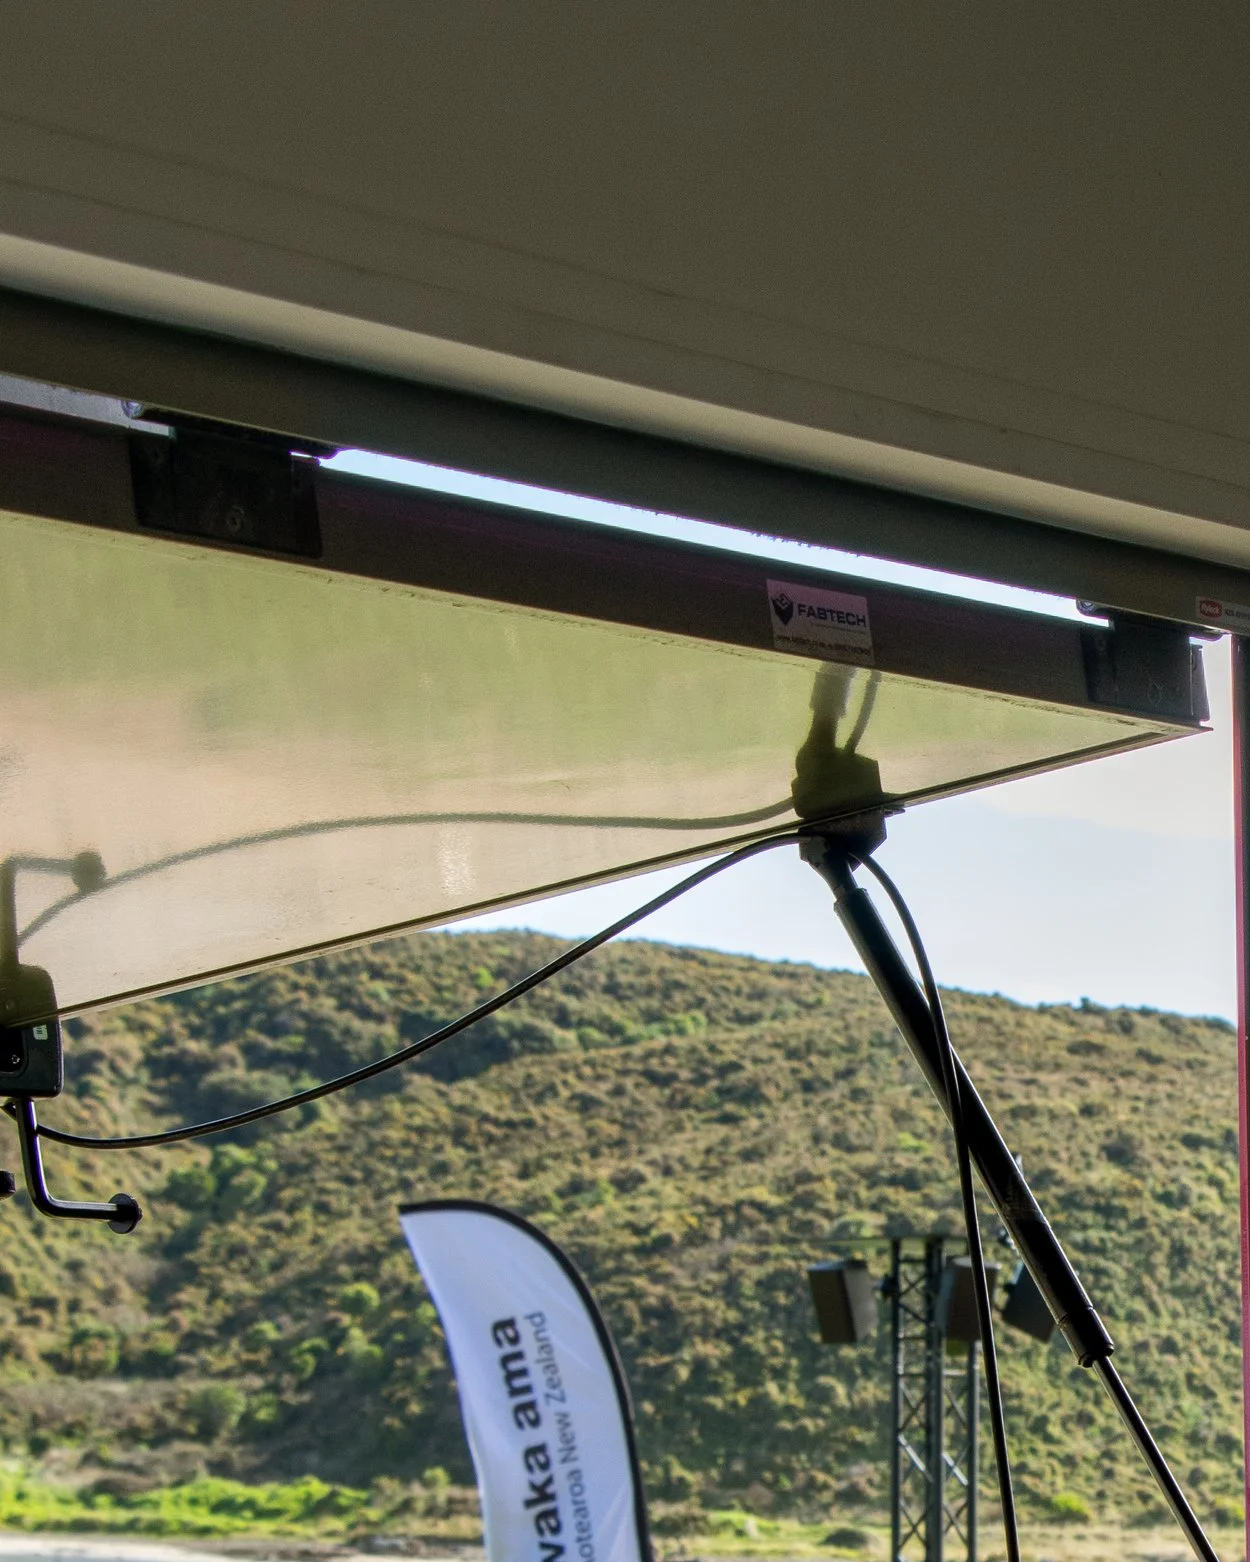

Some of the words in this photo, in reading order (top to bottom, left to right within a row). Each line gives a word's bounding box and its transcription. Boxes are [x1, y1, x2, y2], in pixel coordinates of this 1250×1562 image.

[797, 603, 867, 627] FABTECH
[491, 1317, 542, 1431] ama
[524, 1311, 566, 1405] Zealand
[556, 1411, 578, 1465] New
